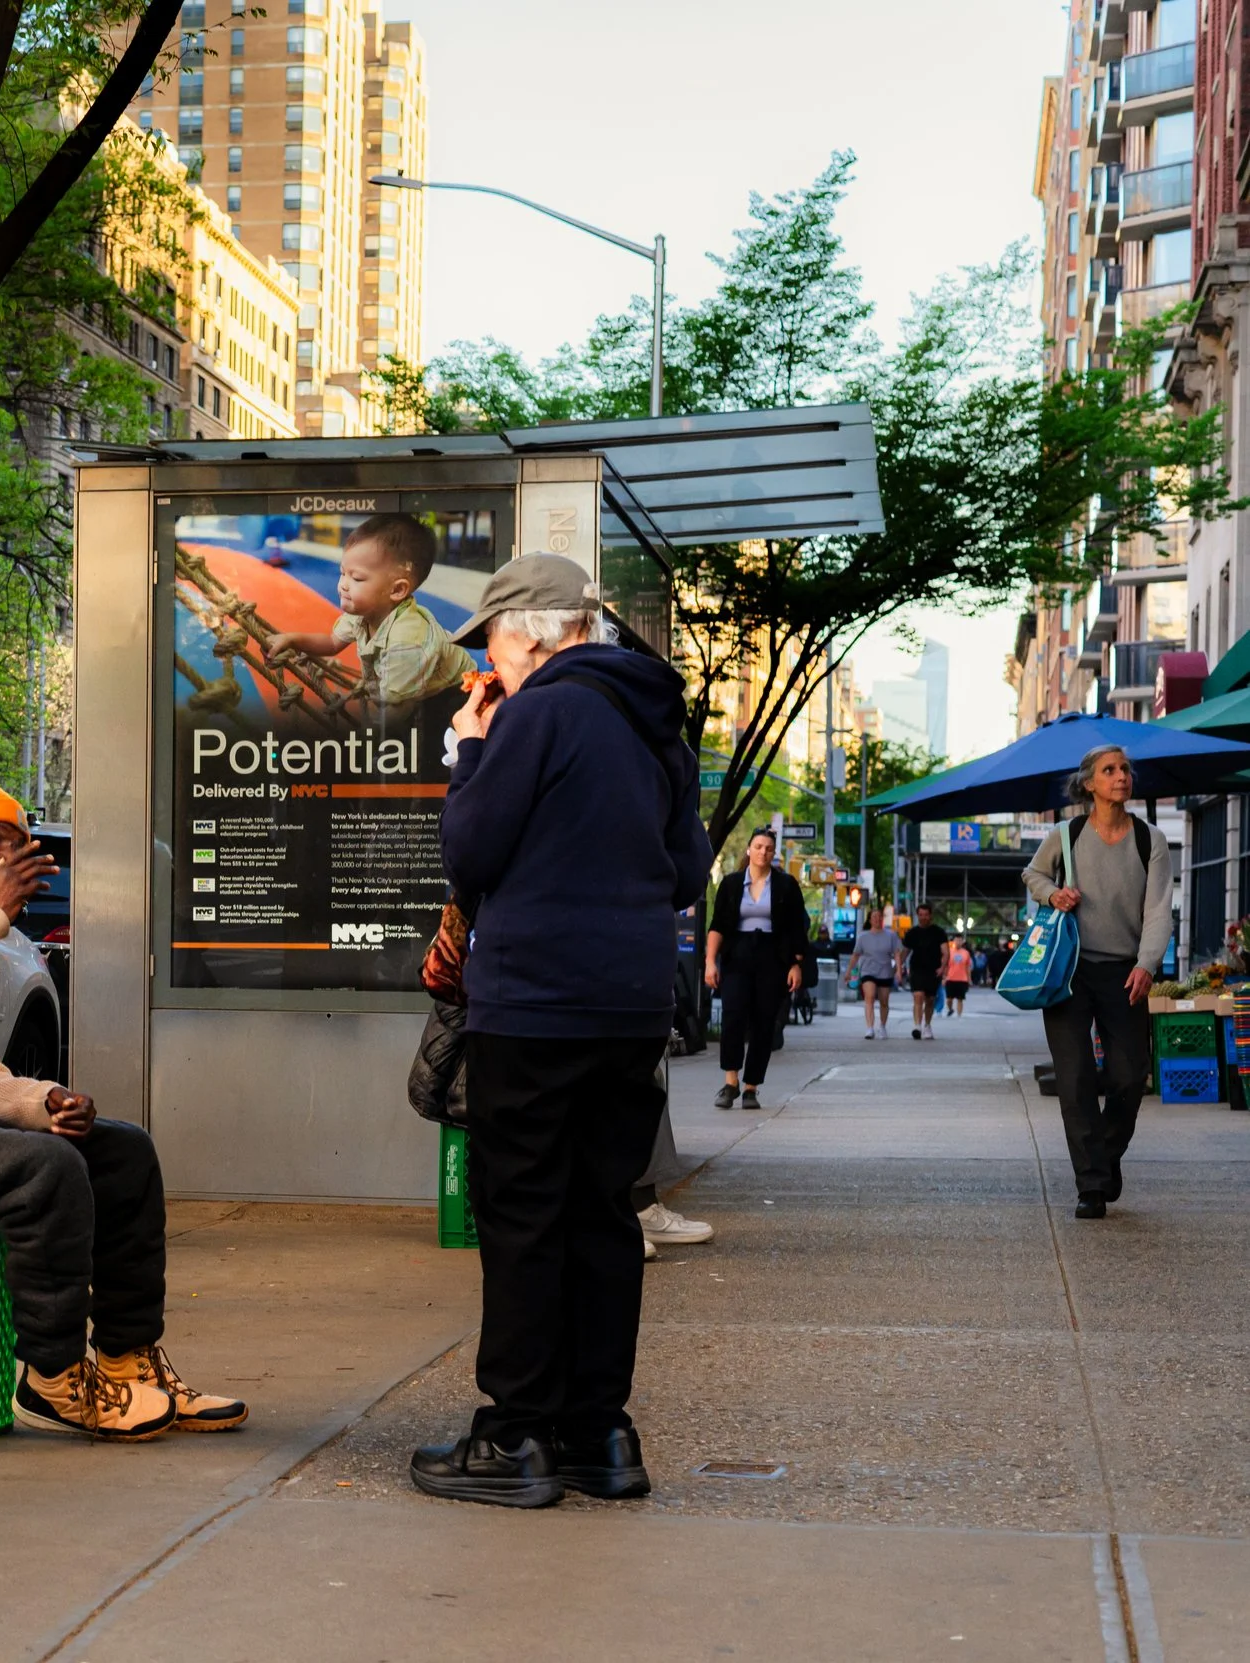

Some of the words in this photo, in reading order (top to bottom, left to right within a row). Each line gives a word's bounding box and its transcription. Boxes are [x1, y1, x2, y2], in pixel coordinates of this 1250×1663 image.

[291, 496, 376, 512] JCDecaux
[550, 509, 576, 557] Ne
[193, 728, 418, 774] Potential
[707, 775, 721, 785] 90
[193, 783, 264, 798] Delivered
[270, 784, 288, 801] By
[292, 785, 330, 798] NYC
[380, 823, 403, 831] through
[377, 877, 392, 885] City's
[420, 877, 449, 885] delivering
[332, 923, 384, 942] NYC
